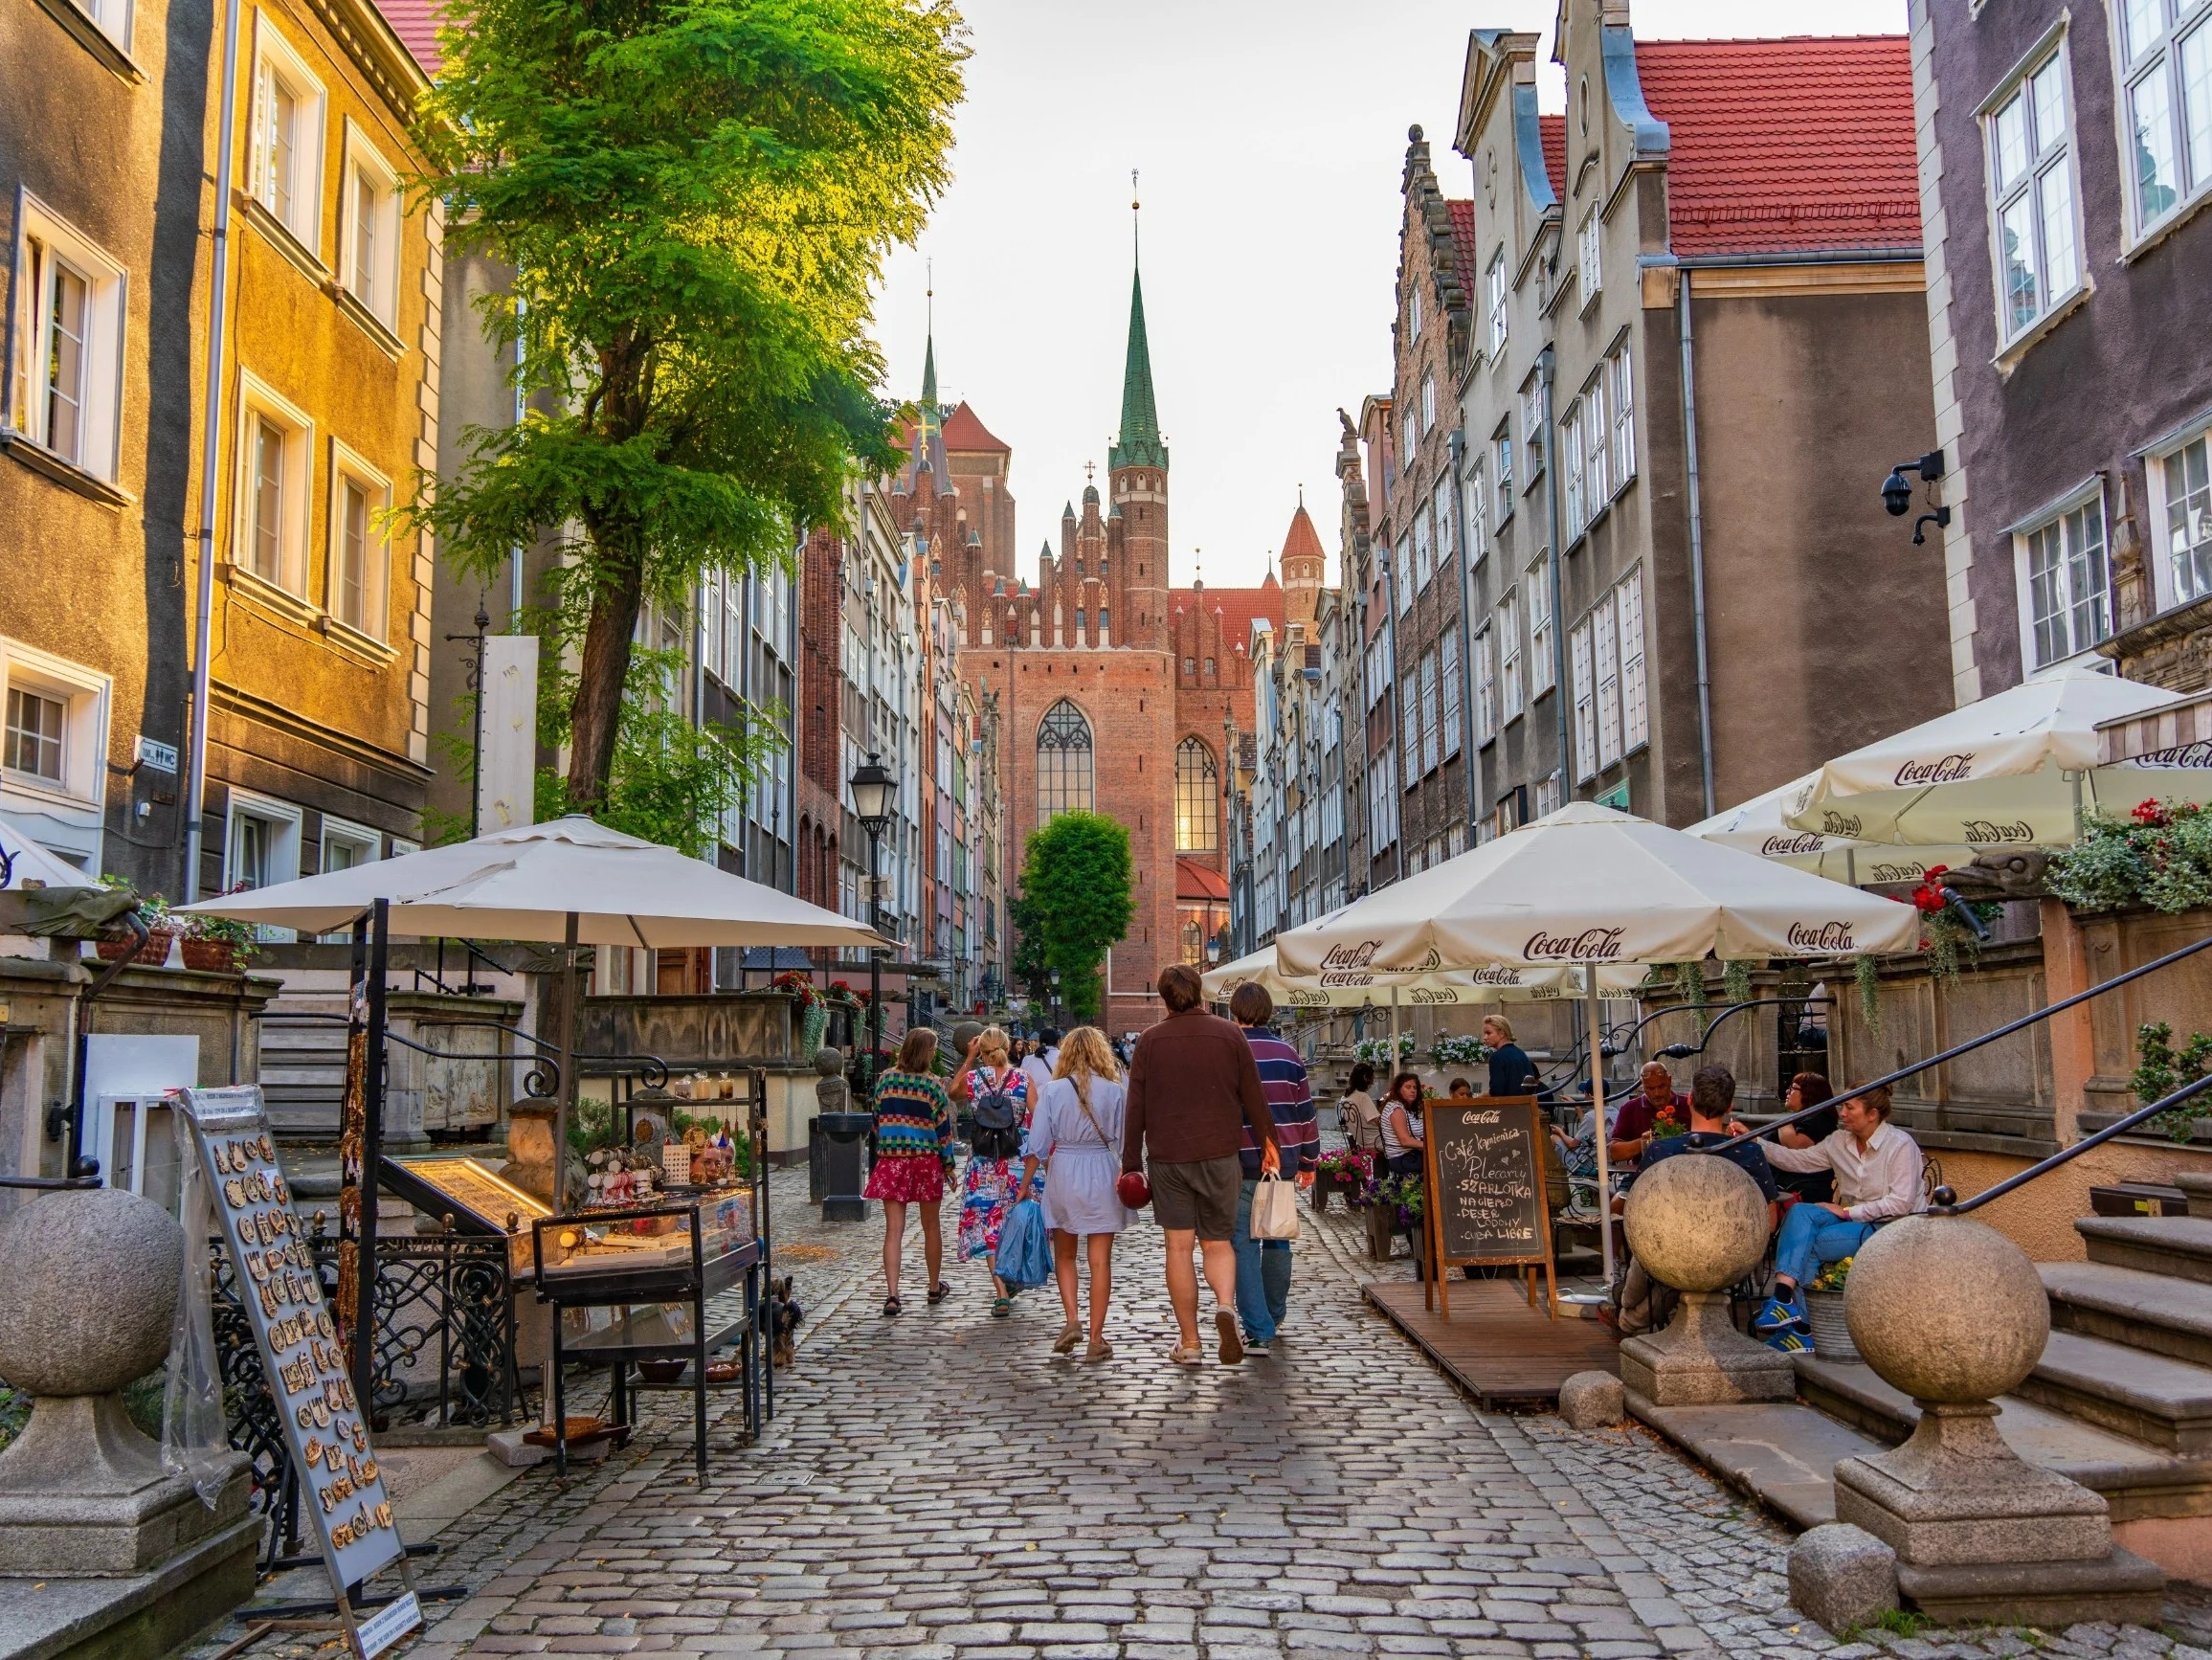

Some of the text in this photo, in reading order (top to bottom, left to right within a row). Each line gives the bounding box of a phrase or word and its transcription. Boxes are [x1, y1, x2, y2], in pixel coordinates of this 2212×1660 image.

[165, 752, 175, 766] WC
[1894, 752, 1977, 786] Coca-Cola
[1761, 832, 1824, 856] Coca-Cola
[1523, 927, 1627, 961] Coca-Cola
[1787, 921, 1855, 951] Coca-Cola
[1472, 968, 1522, 986] Coca-Cola
[1462, 1110, 1501, 1125] Coca-Cola
[1497, 1227, 1533, 1240] LIBRE
